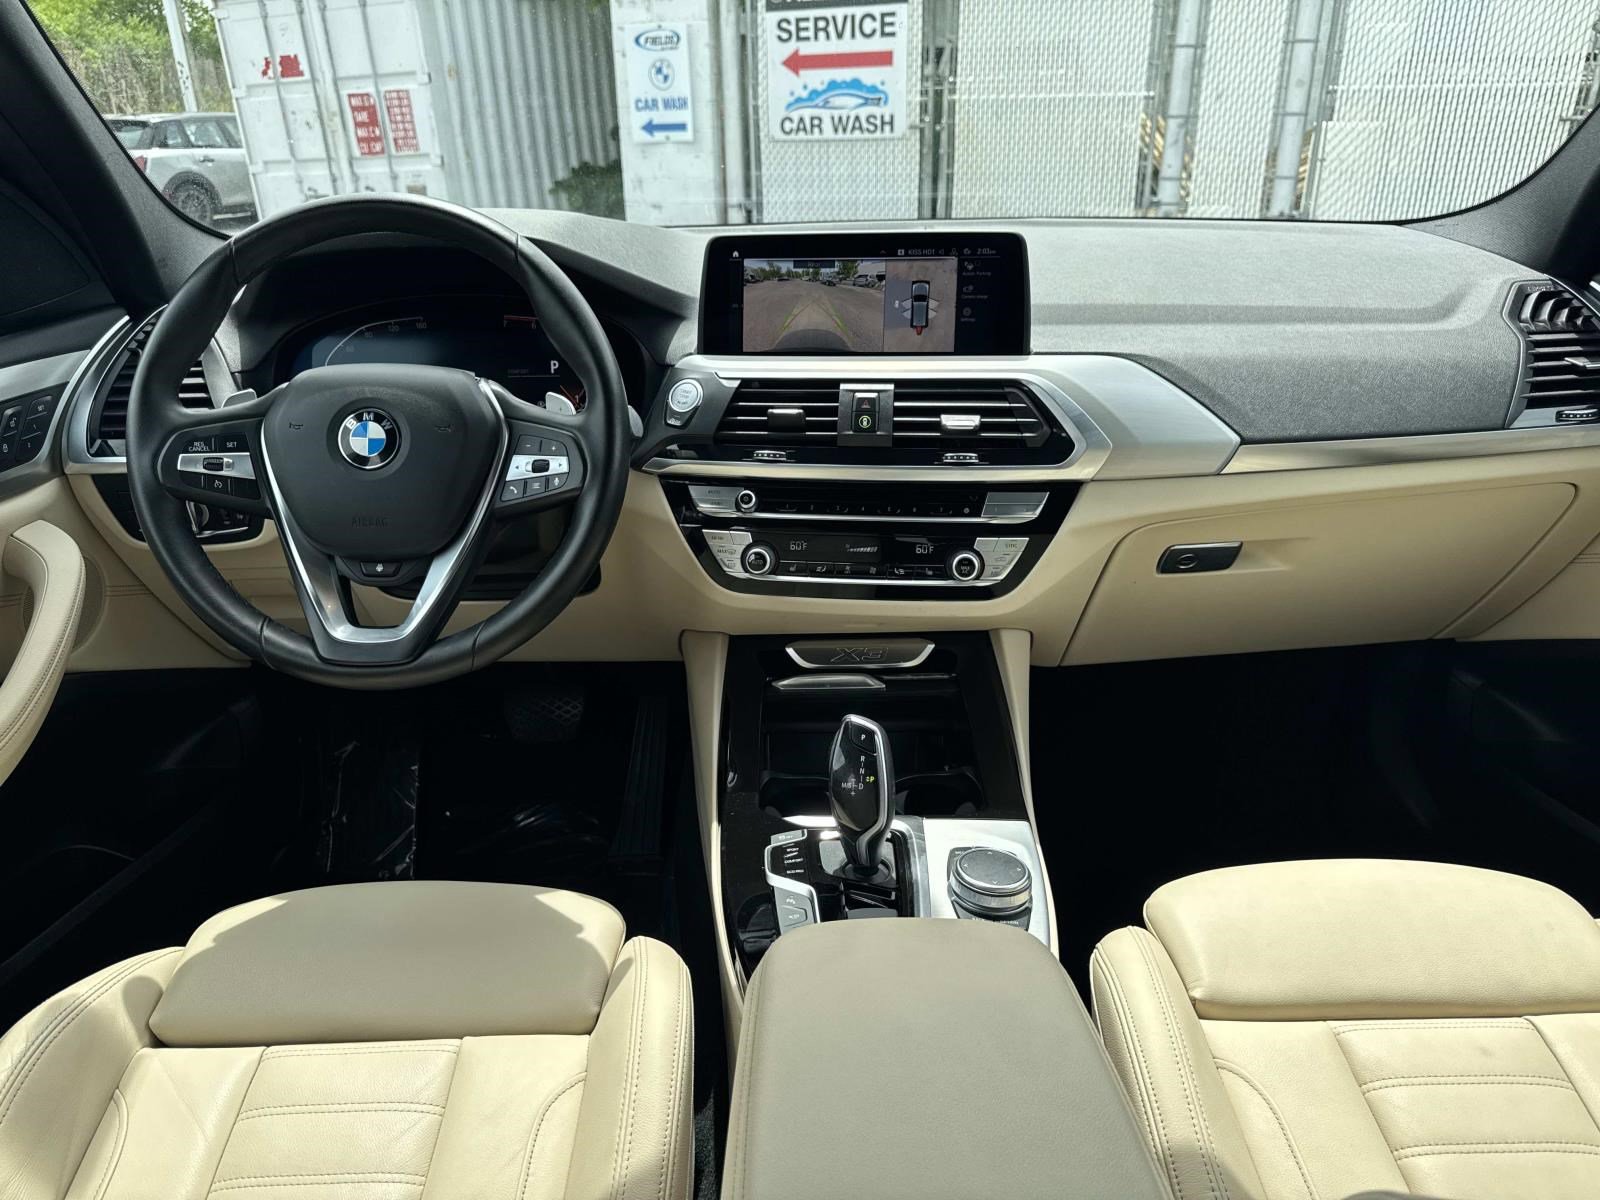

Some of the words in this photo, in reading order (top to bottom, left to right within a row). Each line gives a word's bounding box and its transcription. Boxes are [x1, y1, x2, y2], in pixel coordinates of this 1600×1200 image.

[776, 11, 897, 42] SERVICE
[634, 97, 659, 111] CAR
[662, 96, 688, 111] WASH
[781, 116, 823, 135] CAR
[831, 114, 894, 134] WASH
[550, 360, 559, 374] P
[345, 412, 393, 430] BMW
